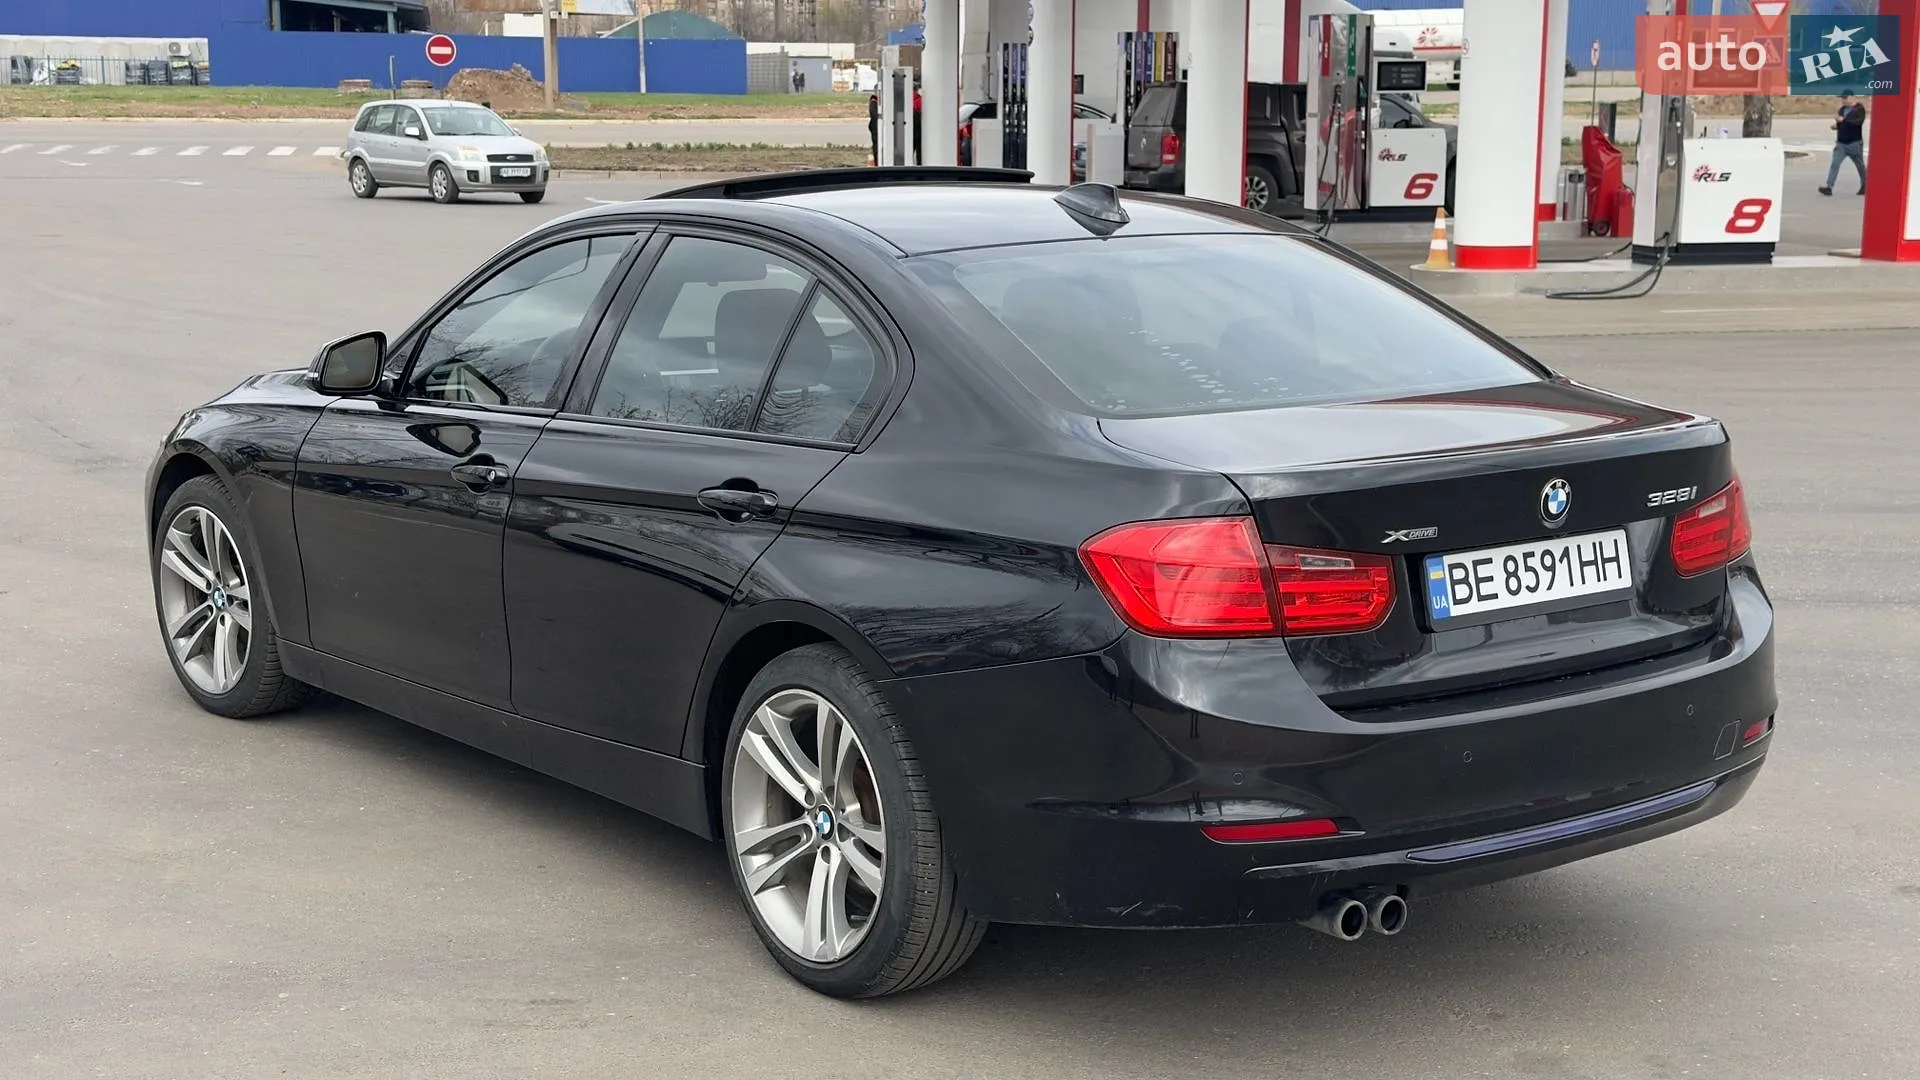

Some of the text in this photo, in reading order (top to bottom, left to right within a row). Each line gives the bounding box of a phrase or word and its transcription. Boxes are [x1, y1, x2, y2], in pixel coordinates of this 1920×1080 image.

[1403, 173, 1439, 200] 6
[1725, 198, 1773, 234] 8
[1433, 594, 1449, 610] UA
[1448, 557, 1499, 606] BE
